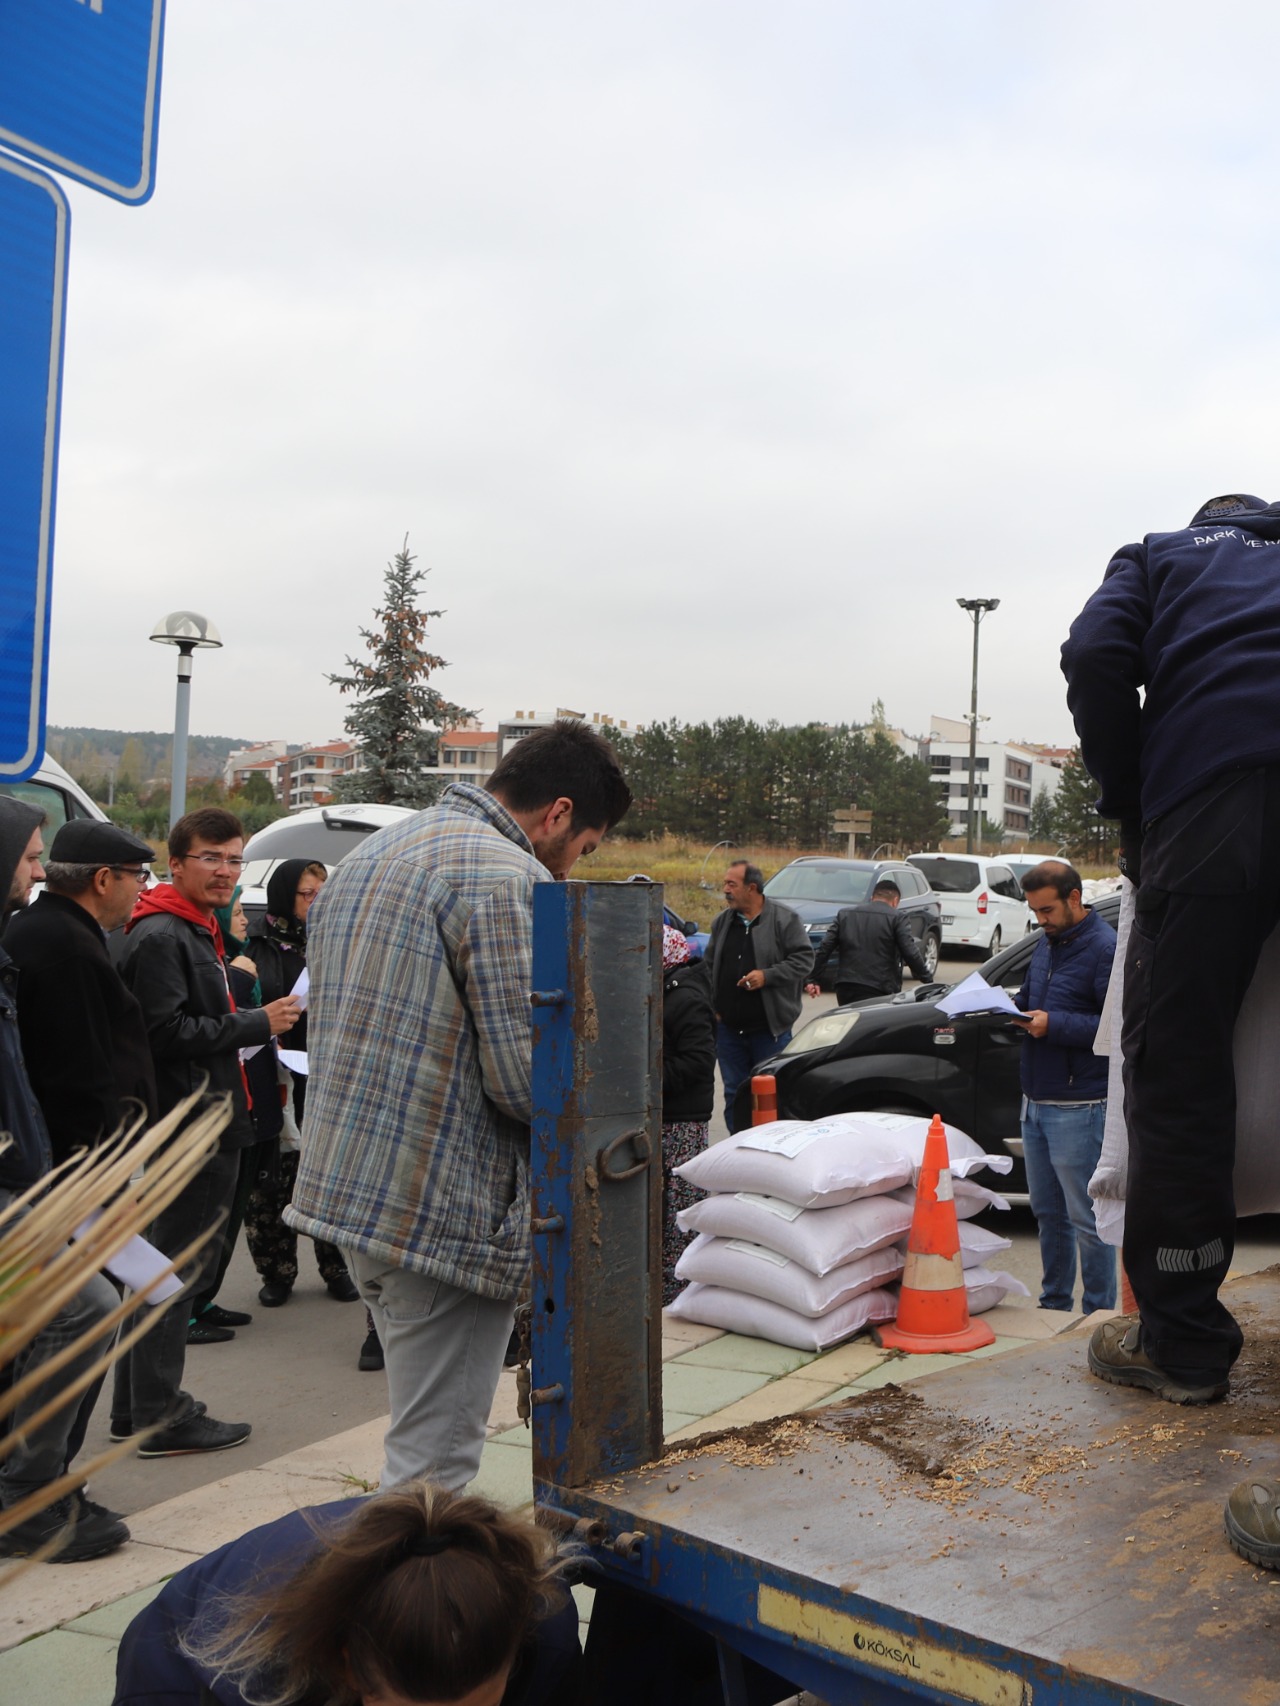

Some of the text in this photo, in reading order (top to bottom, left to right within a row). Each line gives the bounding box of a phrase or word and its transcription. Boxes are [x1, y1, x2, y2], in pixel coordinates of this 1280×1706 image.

[1194, 530, 1237, 546] PARK
[1242, 534, 1263, 548] VE
[867, 1640, 921, 1669] KÖKSAL
